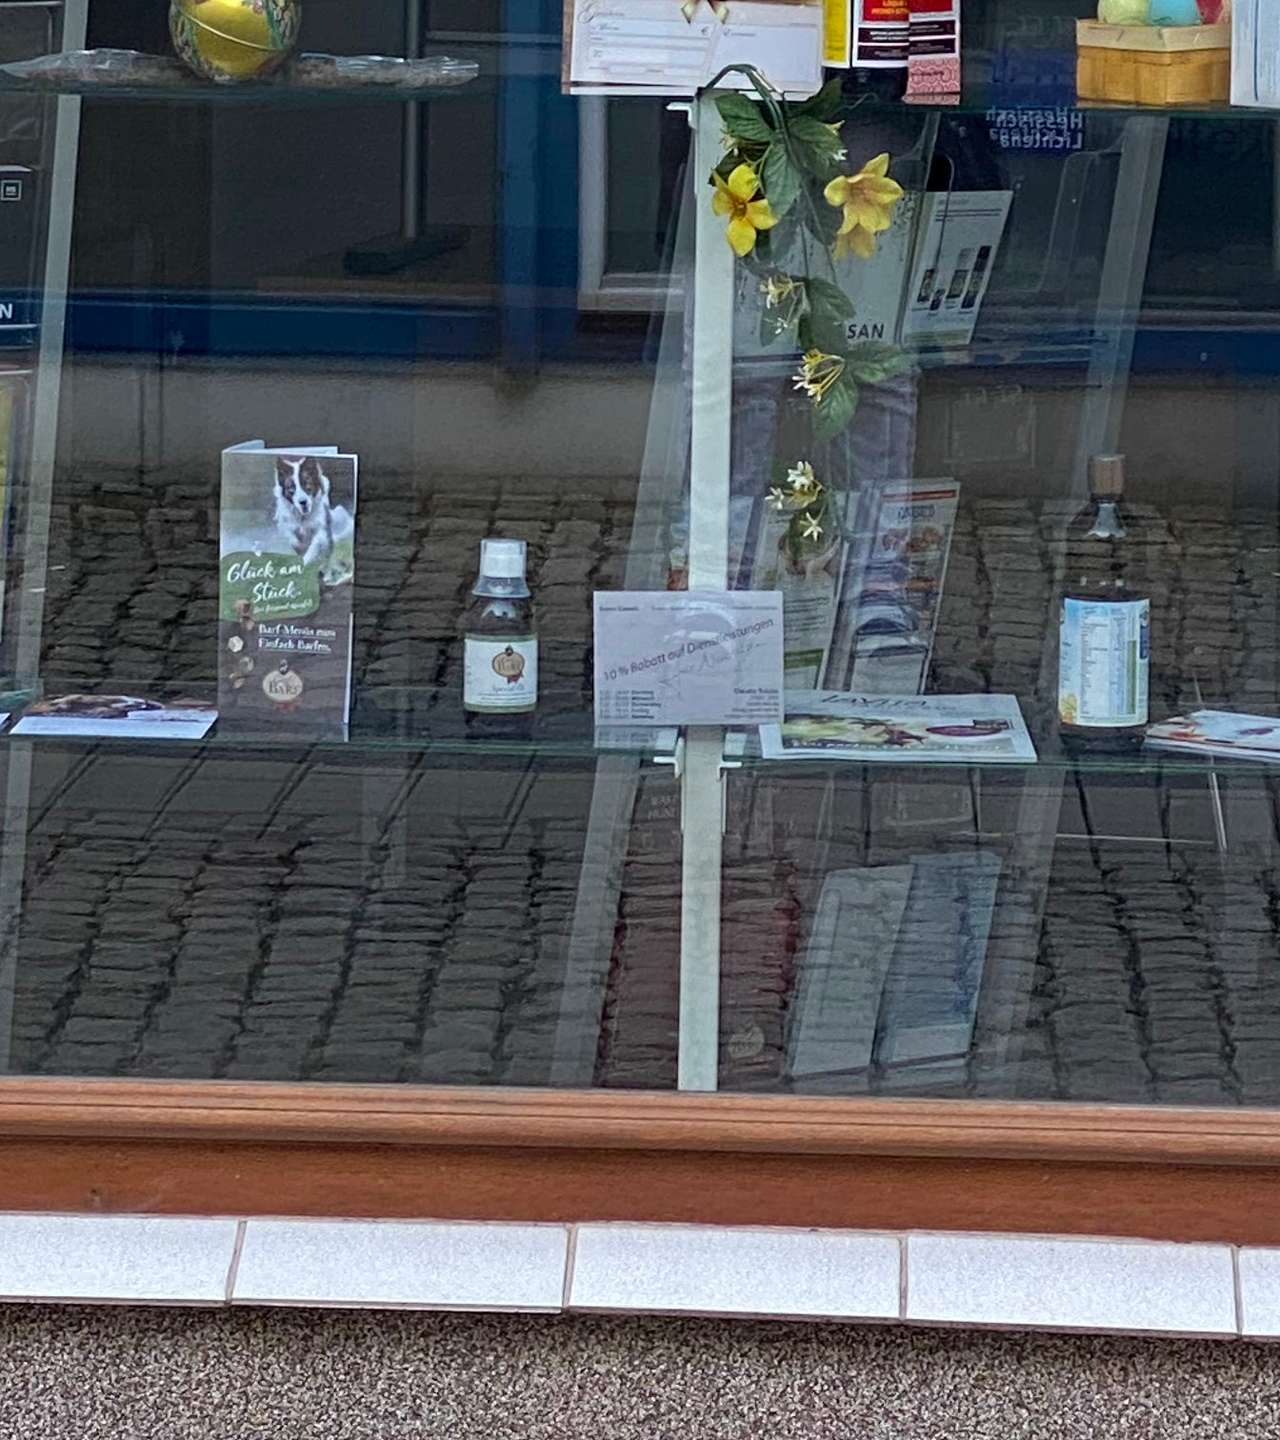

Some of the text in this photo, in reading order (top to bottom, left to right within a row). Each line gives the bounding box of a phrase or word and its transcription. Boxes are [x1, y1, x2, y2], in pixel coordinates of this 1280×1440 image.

[847, 323, 885, 339] SAN
[226, 560, 303, 583] Glück am
[603, 669, 618, 682] 10
[619, 666, 630, 677] %
[629, 652, 668, 673] Rabatt
[667, 643, 686, 662] auf
